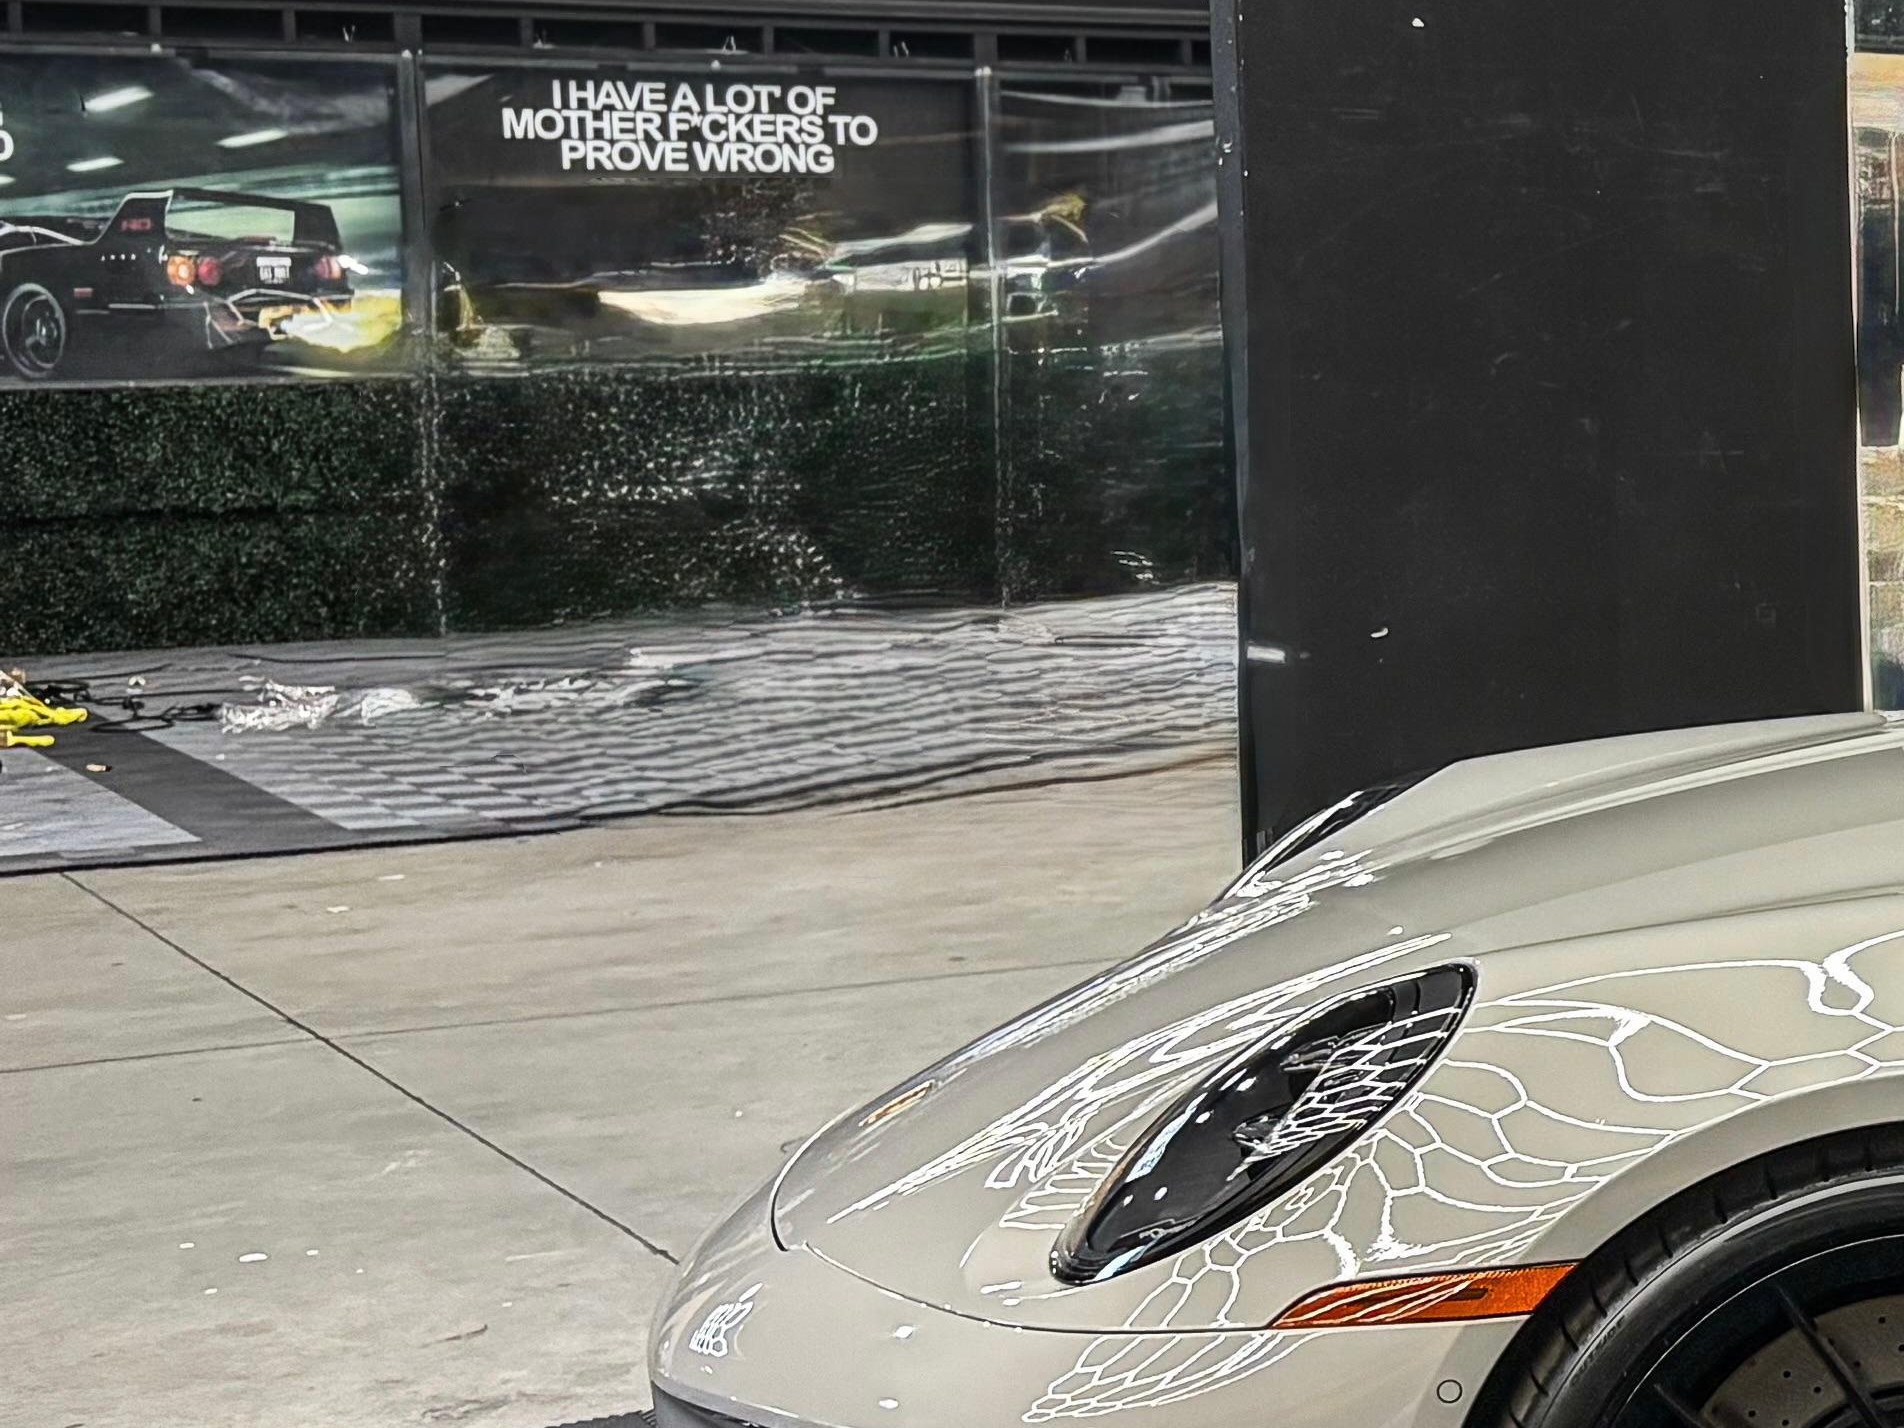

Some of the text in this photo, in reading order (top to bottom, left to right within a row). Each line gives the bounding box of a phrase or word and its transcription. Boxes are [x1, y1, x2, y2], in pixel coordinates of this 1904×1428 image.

[552, 79, 562, 110] I
[568, 80, 667, 112] HAVE
[671, 82, 701, 112] A
[786, 85, 836, 116] OF
[501, 107, 663, 142] MOTHER
[828, 114, 880, 146] TO
[560, 139, 836, 175] PROVE WRONG
